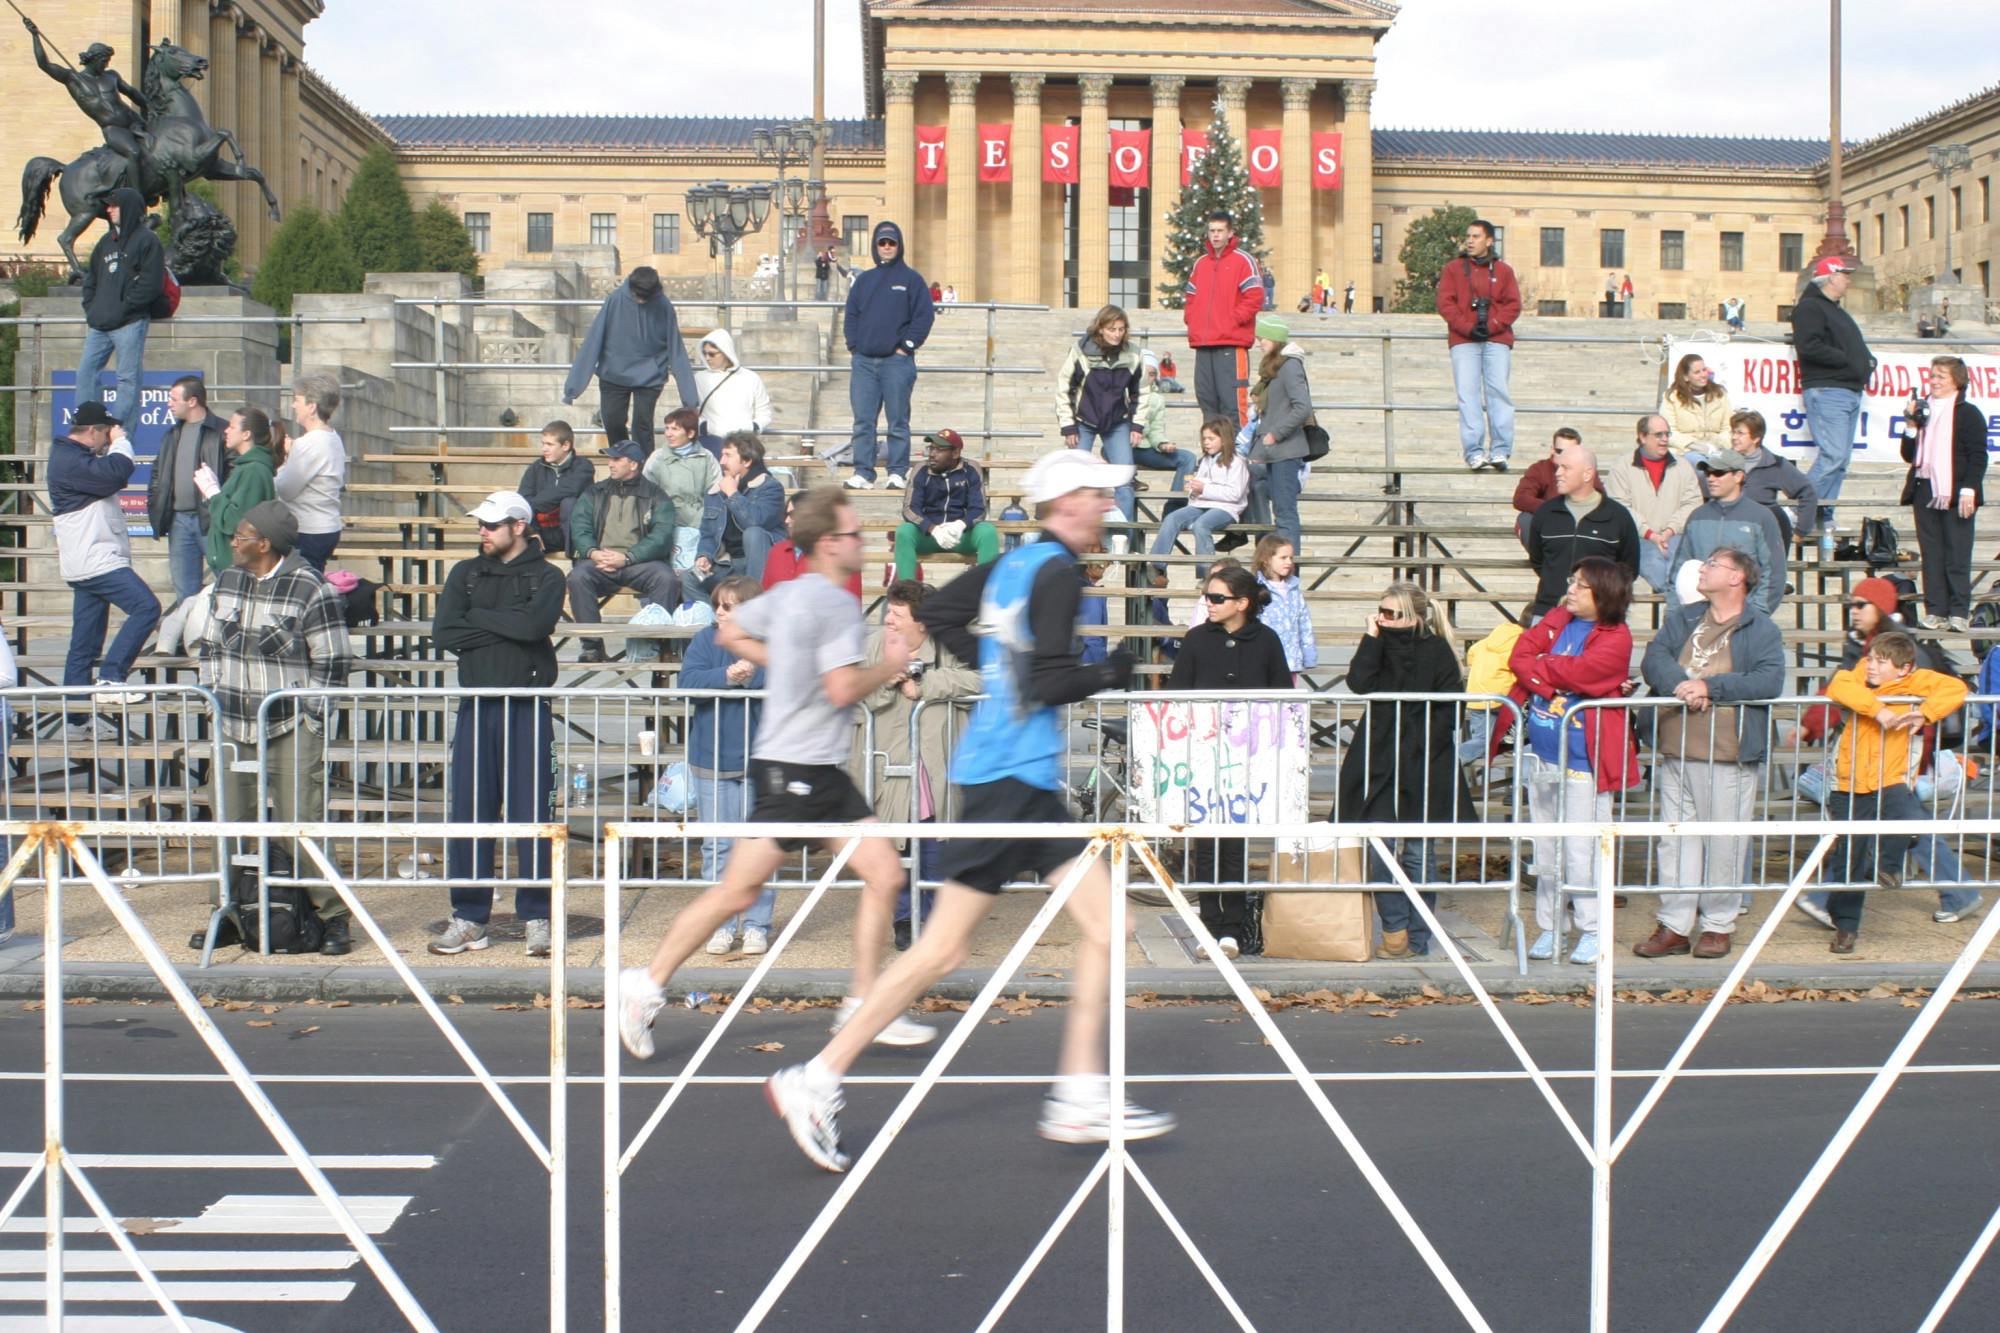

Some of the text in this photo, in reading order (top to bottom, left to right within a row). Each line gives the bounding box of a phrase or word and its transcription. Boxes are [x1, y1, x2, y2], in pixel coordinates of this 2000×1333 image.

[1743, 358, 1804, 395] KORE
[1864, 363, 1912, 398] OAD
[141, 407, 162, 425] of
